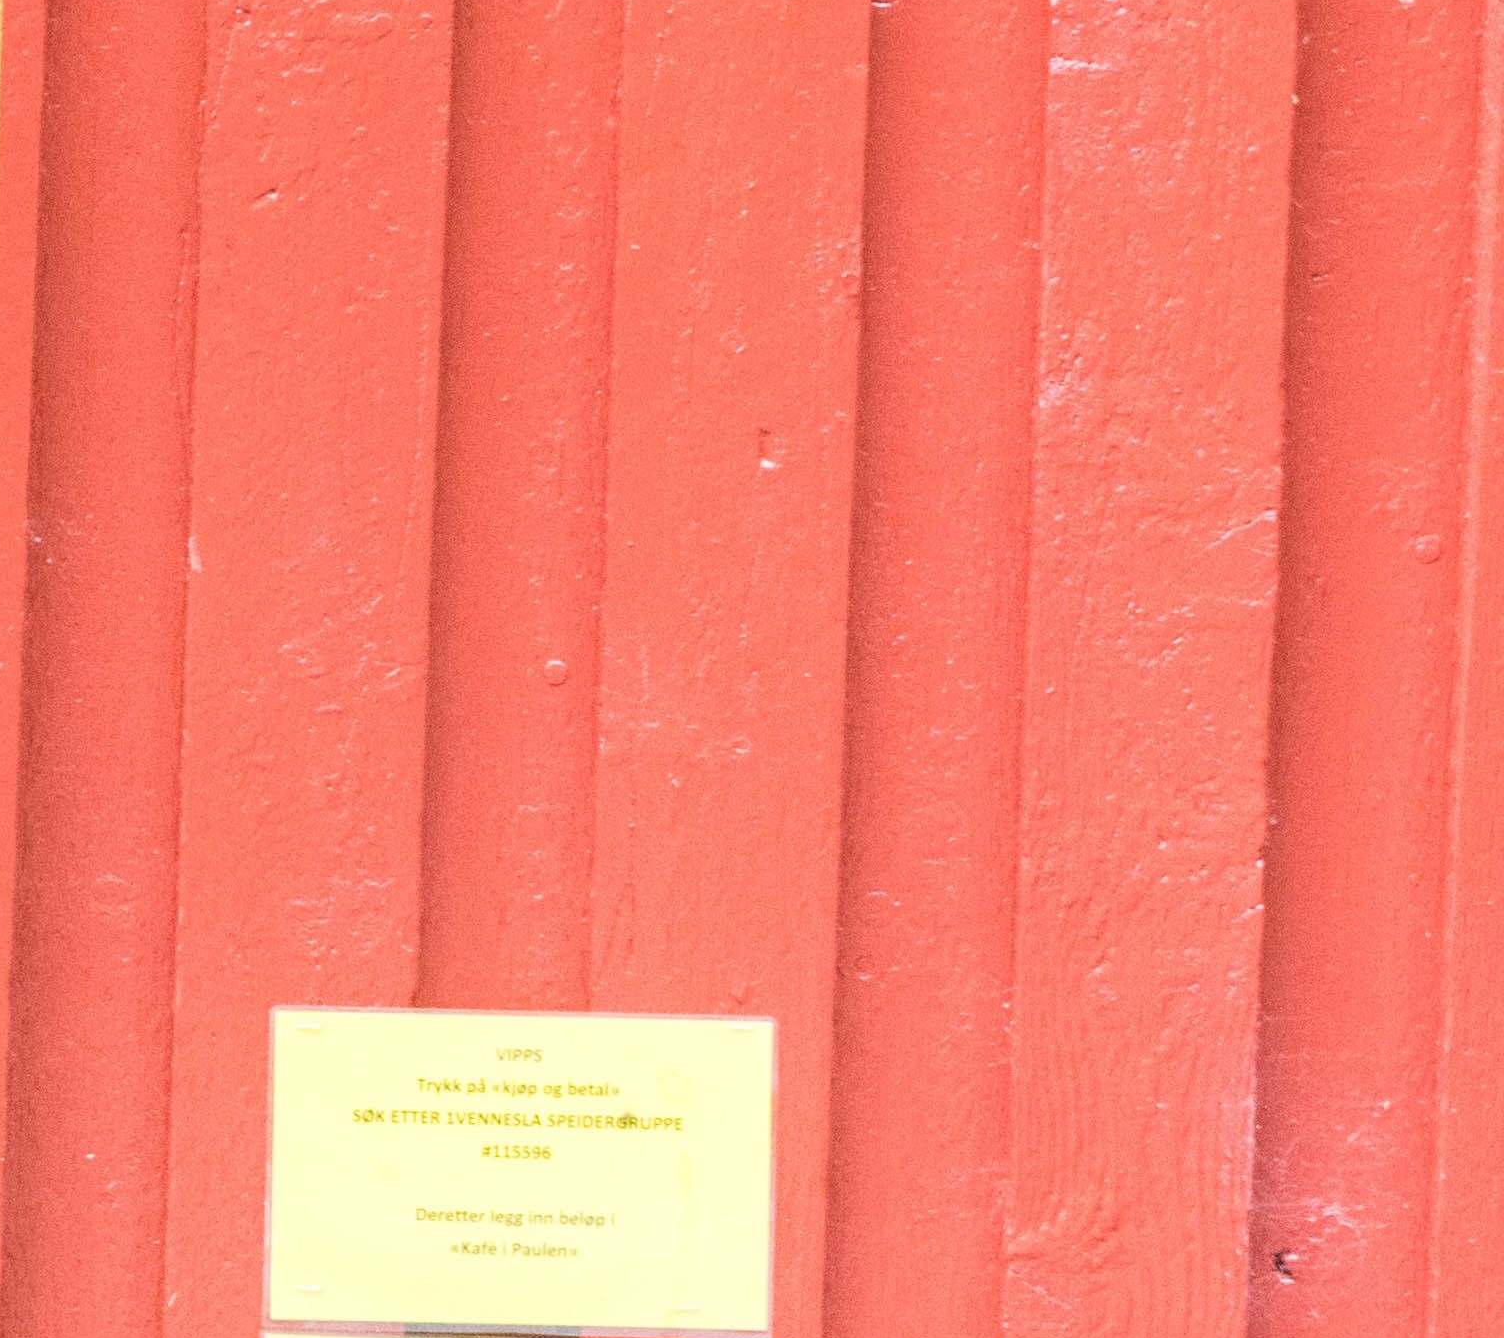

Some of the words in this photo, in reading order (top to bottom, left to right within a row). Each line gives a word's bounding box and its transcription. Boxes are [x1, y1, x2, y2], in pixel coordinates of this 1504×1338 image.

[495, 1048, 543, 1063] VIPPS
[416, 1077, 462, 1095] Trykk
[466, 1078, 487, 1096] på
[542, 1084, 563, 1100] og
[352, 1108, 386, 1124] SØK
[390, 1109, 441, 1125] ETTER
[446, 1111, 543, 1128] 1VENNESLA
[546, 1112, 683, 1132] SPEIDERGRUPPE
[481, 1144, 552, 1161] #115596
[415, 1207, 486, 1223] Deretter
[489, 1209, 525, 1228] legg
[527, 1211, 554, 1225] inn
[558, 1210, 606, 1228] beløp
